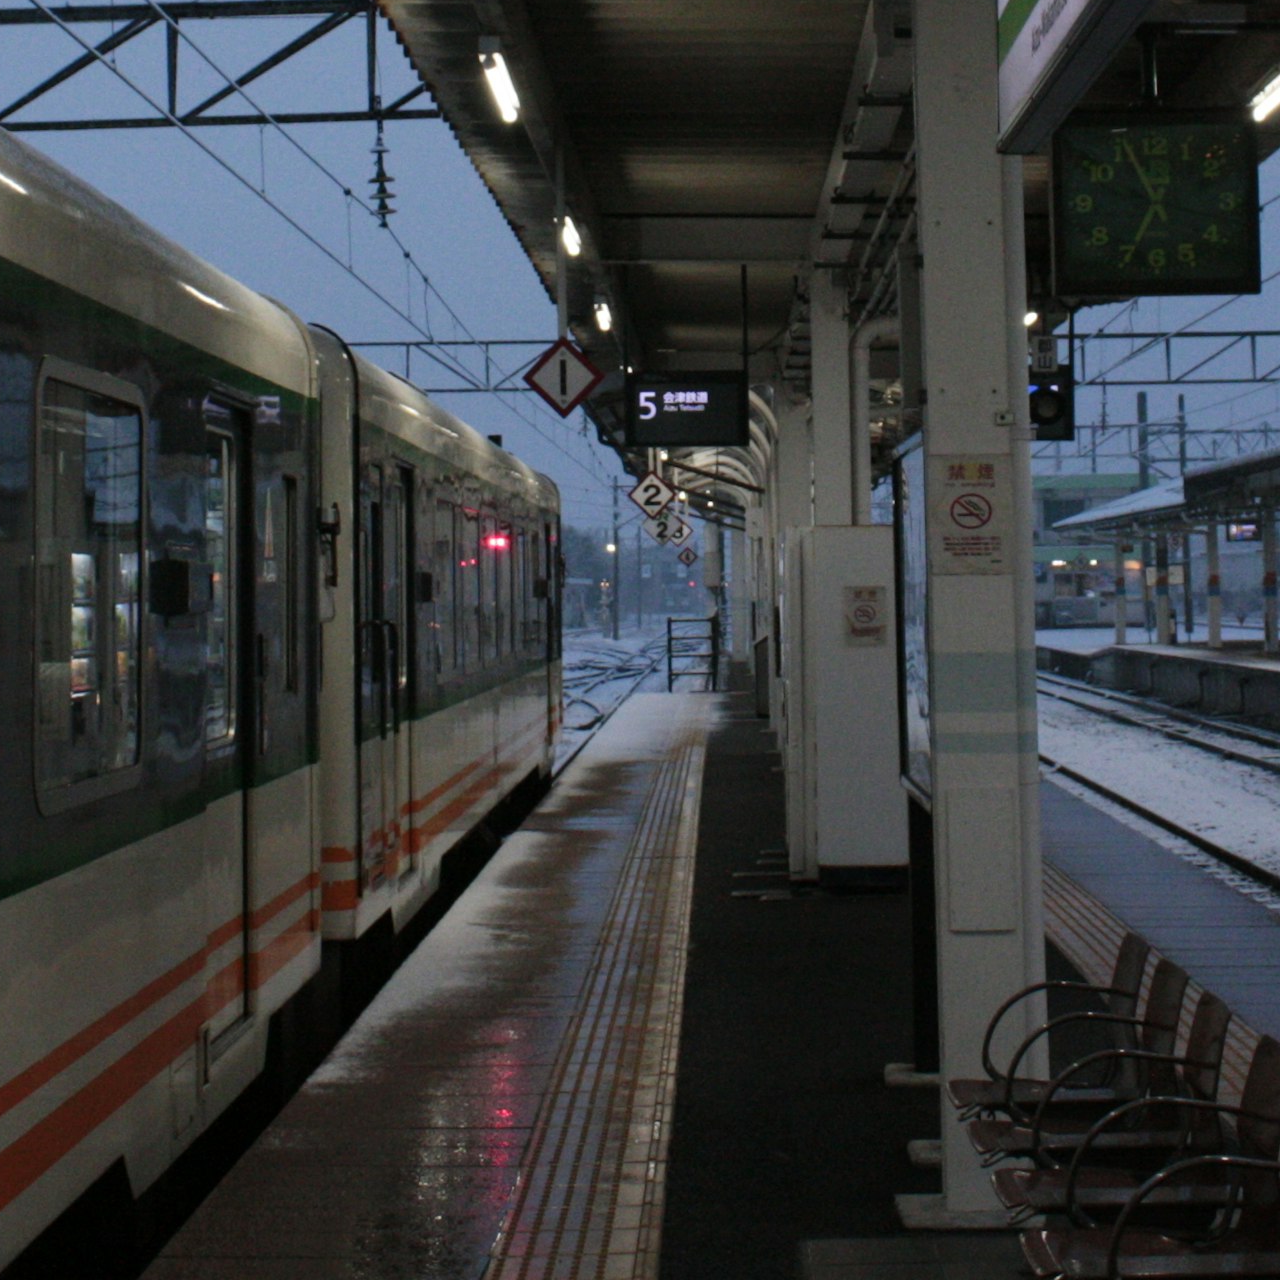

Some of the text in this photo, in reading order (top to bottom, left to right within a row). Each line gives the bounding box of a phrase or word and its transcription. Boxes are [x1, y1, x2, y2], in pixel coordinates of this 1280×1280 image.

[1143, 137, 1168, 155] 12
[1089, 163, 1114, 182] 10
[1075, 194, 1093, 213] 9
[1220, 192, 1235, 211] 3
[1091, 226, 1109, 245] 8
[1204, 224, 1219, 243] 4
[1120, 245, 1136, 263] 7
[1148, 248, 1166, 267] 6
[1177, 243, 1195, 262] 5
[639, 391, 657, 419] 5
[643, 484, 662, 506] 2
[656, 521, 668, 538] 2
